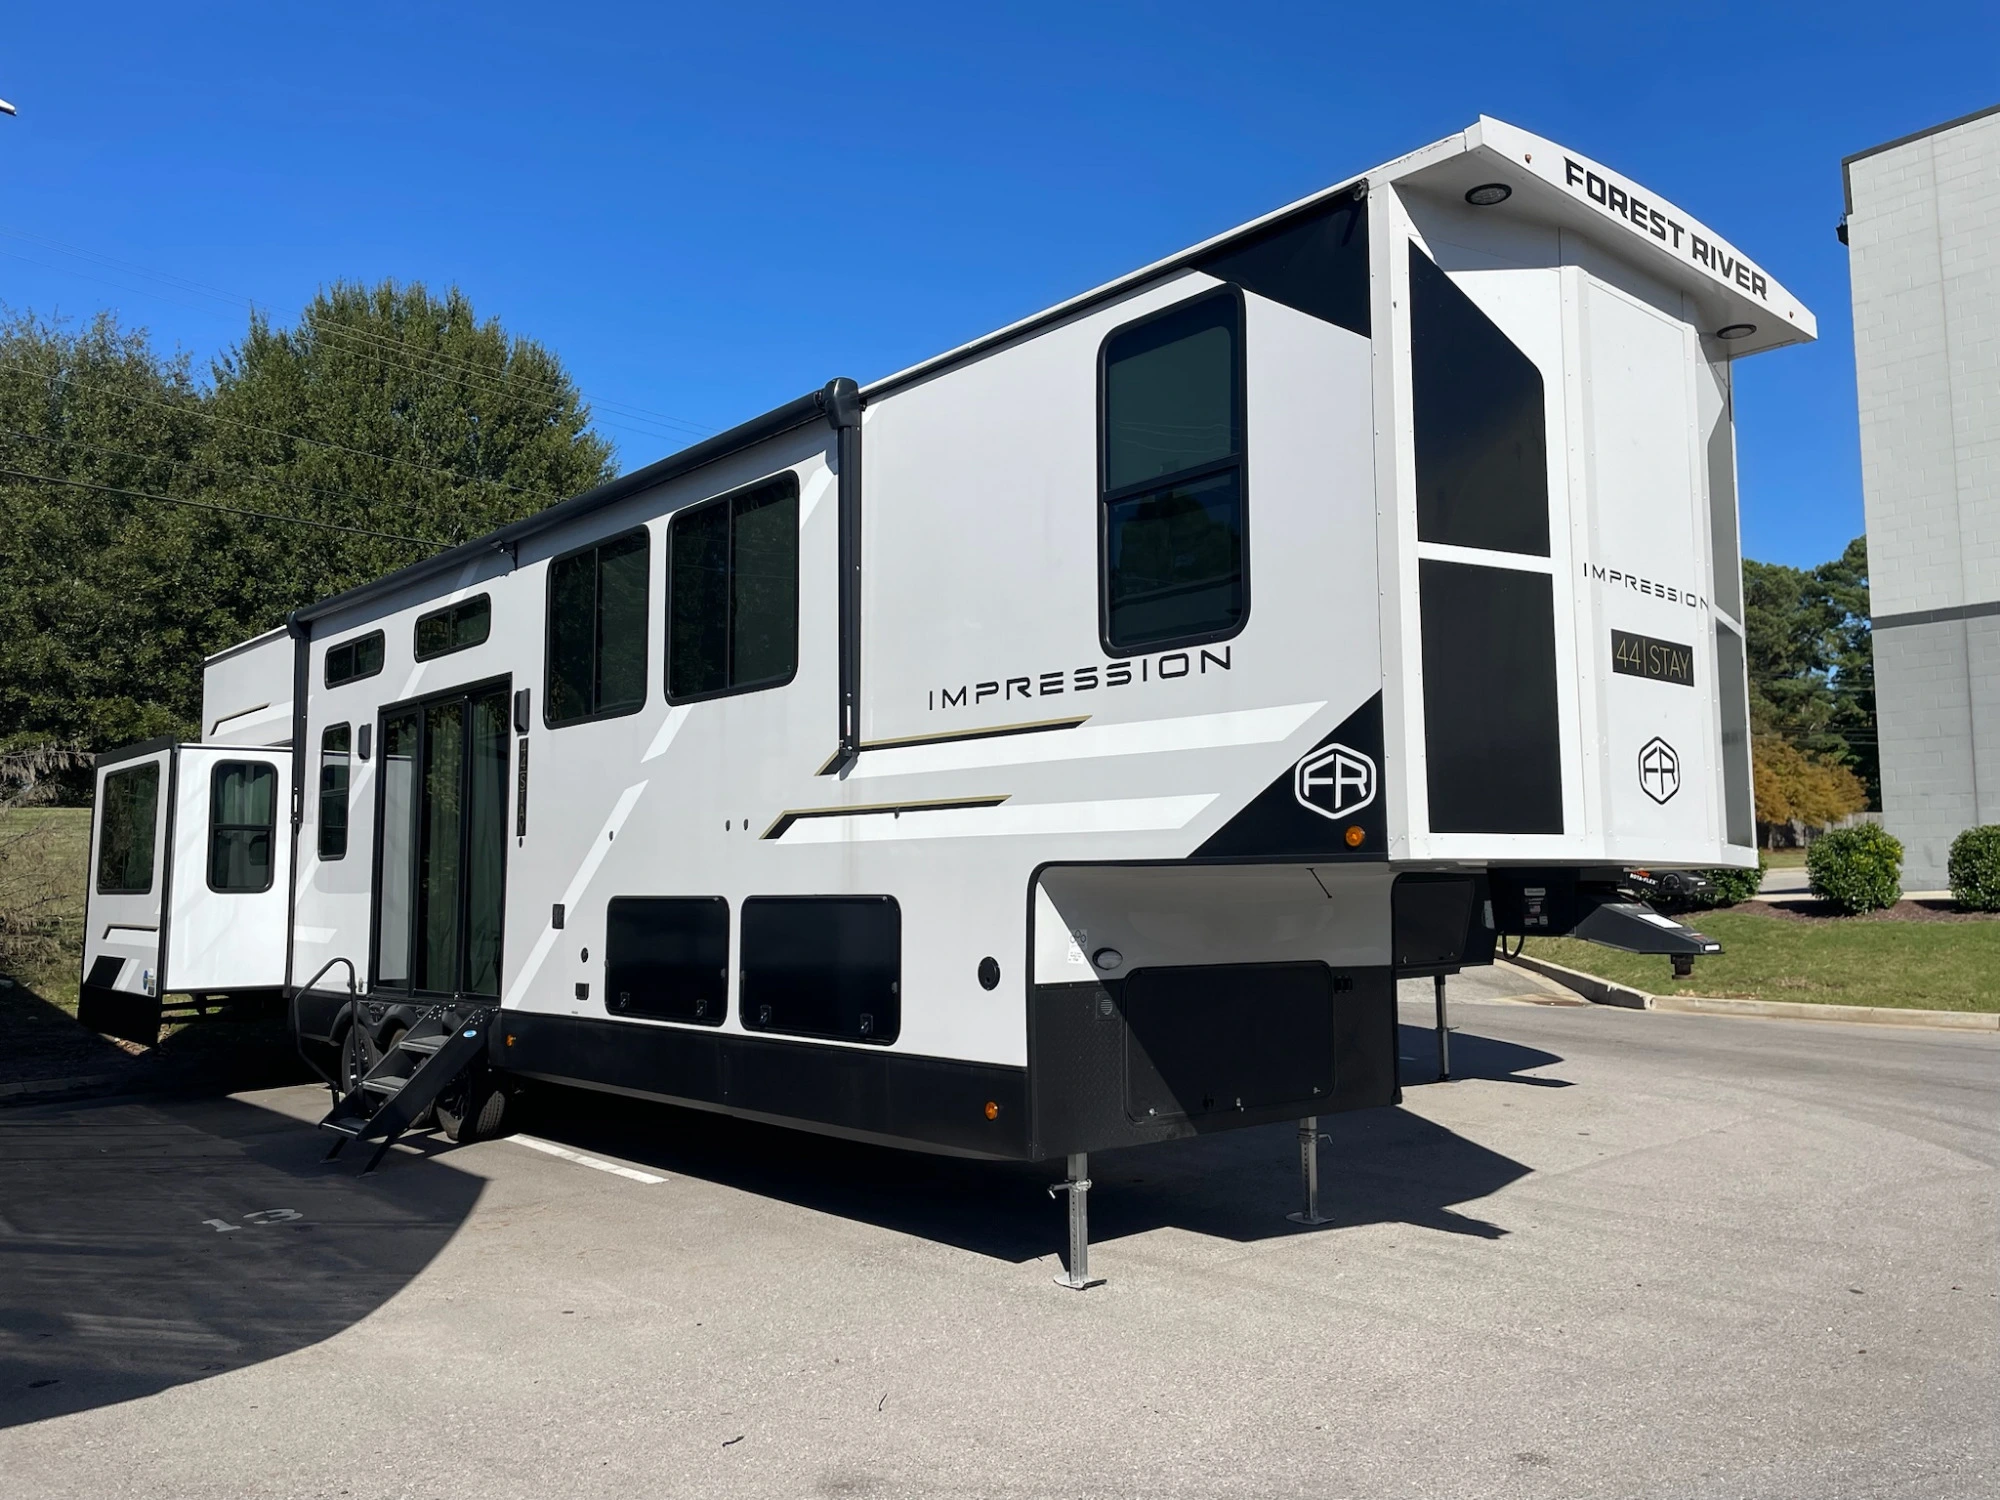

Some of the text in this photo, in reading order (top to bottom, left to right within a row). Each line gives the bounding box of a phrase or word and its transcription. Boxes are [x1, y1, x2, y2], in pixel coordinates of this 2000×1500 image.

[1564, 157, 1768, 301] FOREST RIVER
[1584, 563, 1709, 610] IMPRESSION
[929, 645, 1232, 711] IMPRESSION
[202, 1208, 304, 1233] 13
